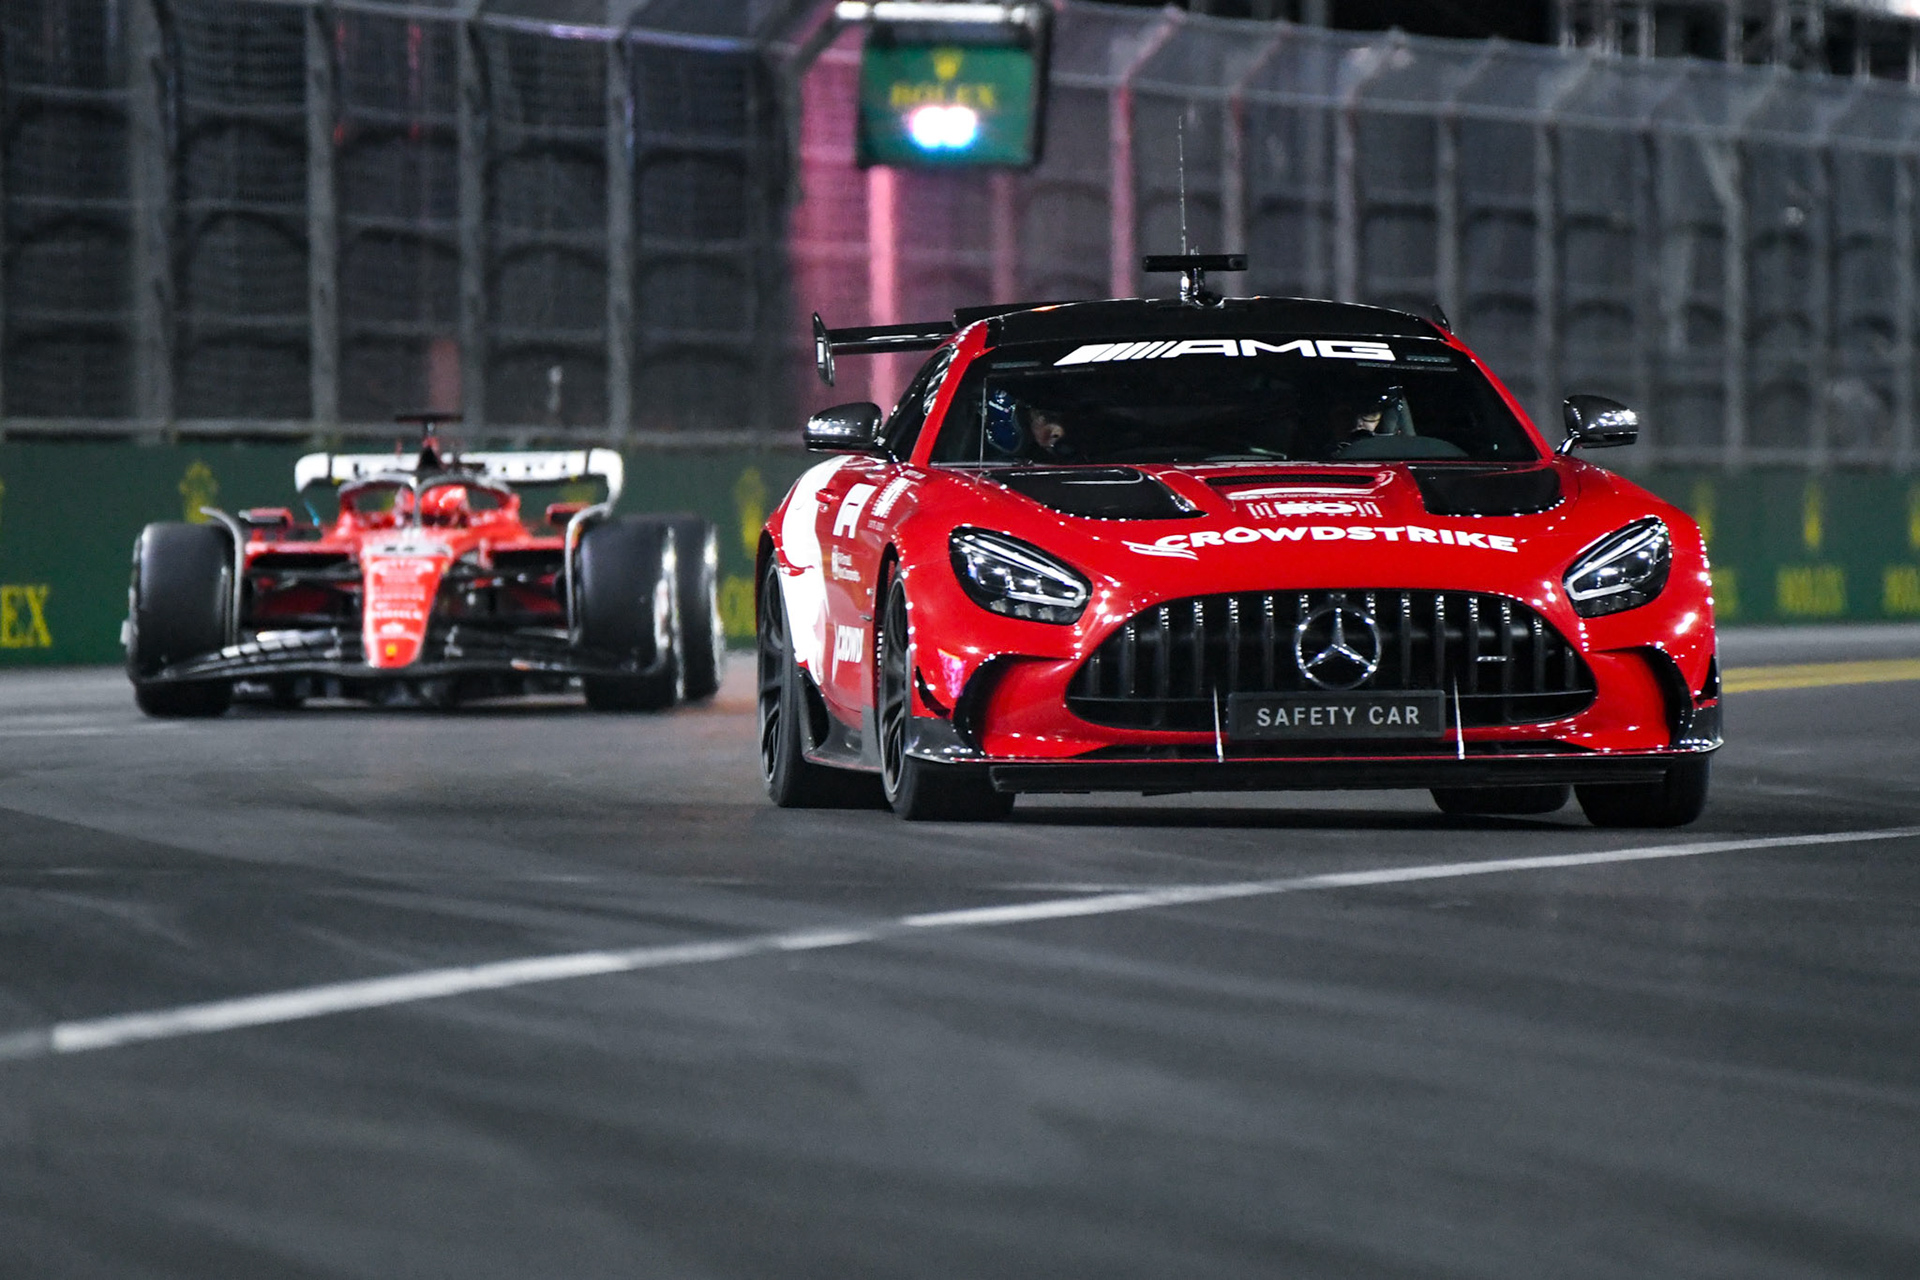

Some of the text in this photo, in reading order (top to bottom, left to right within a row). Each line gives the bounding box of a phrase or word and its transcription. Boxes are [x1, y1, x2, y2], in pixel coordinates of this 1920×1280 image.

[1163, 338, 1398, 362] AMG
[1152, 524, 1519, 553] CROWDSTRIKE
[1256, 705, 1420, 727] SAFETY CAR
